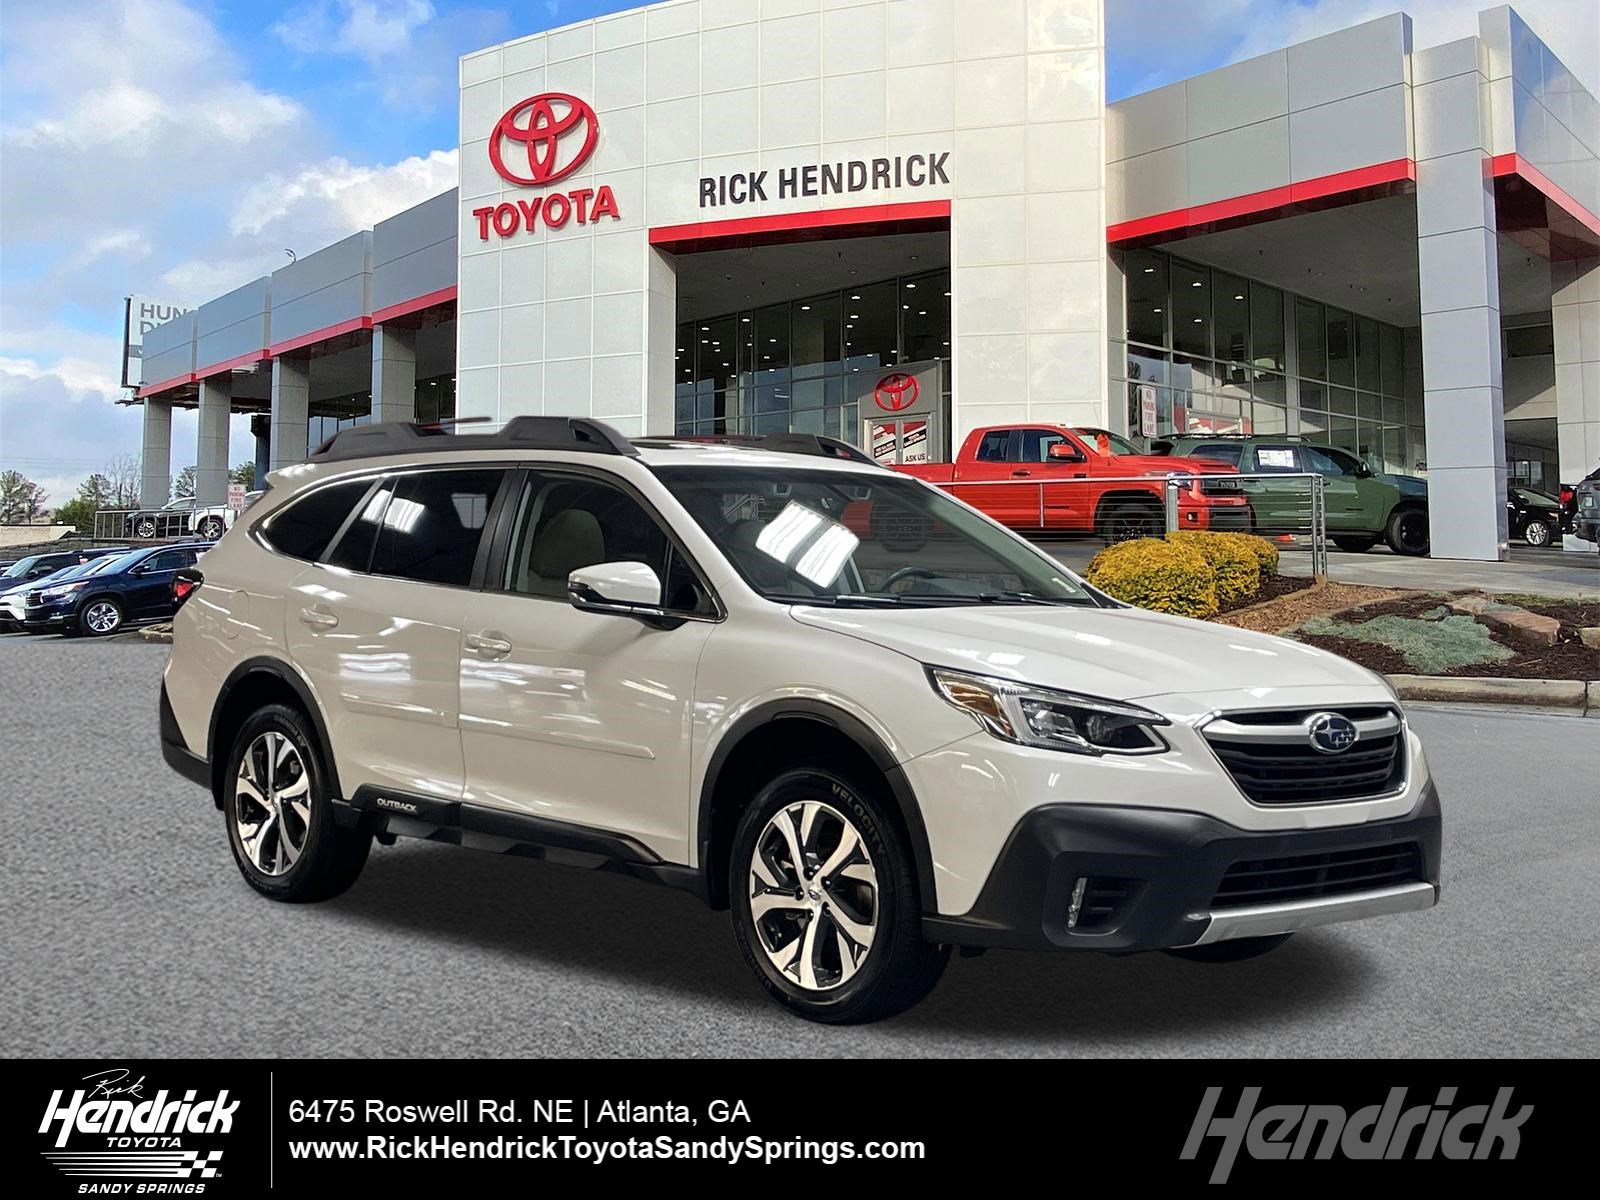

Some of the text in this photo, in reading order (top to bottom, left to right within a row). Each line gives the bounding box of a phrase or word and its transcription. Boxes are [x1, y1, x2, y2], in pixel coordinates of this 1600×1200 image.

[699, 152, 951, 208] RICK HENDRICK
[473, 185, 621, 241] TOYOTA
[904, 453, 926, 463] ASK US
[376, 797, 417, 813] OUTBACK
